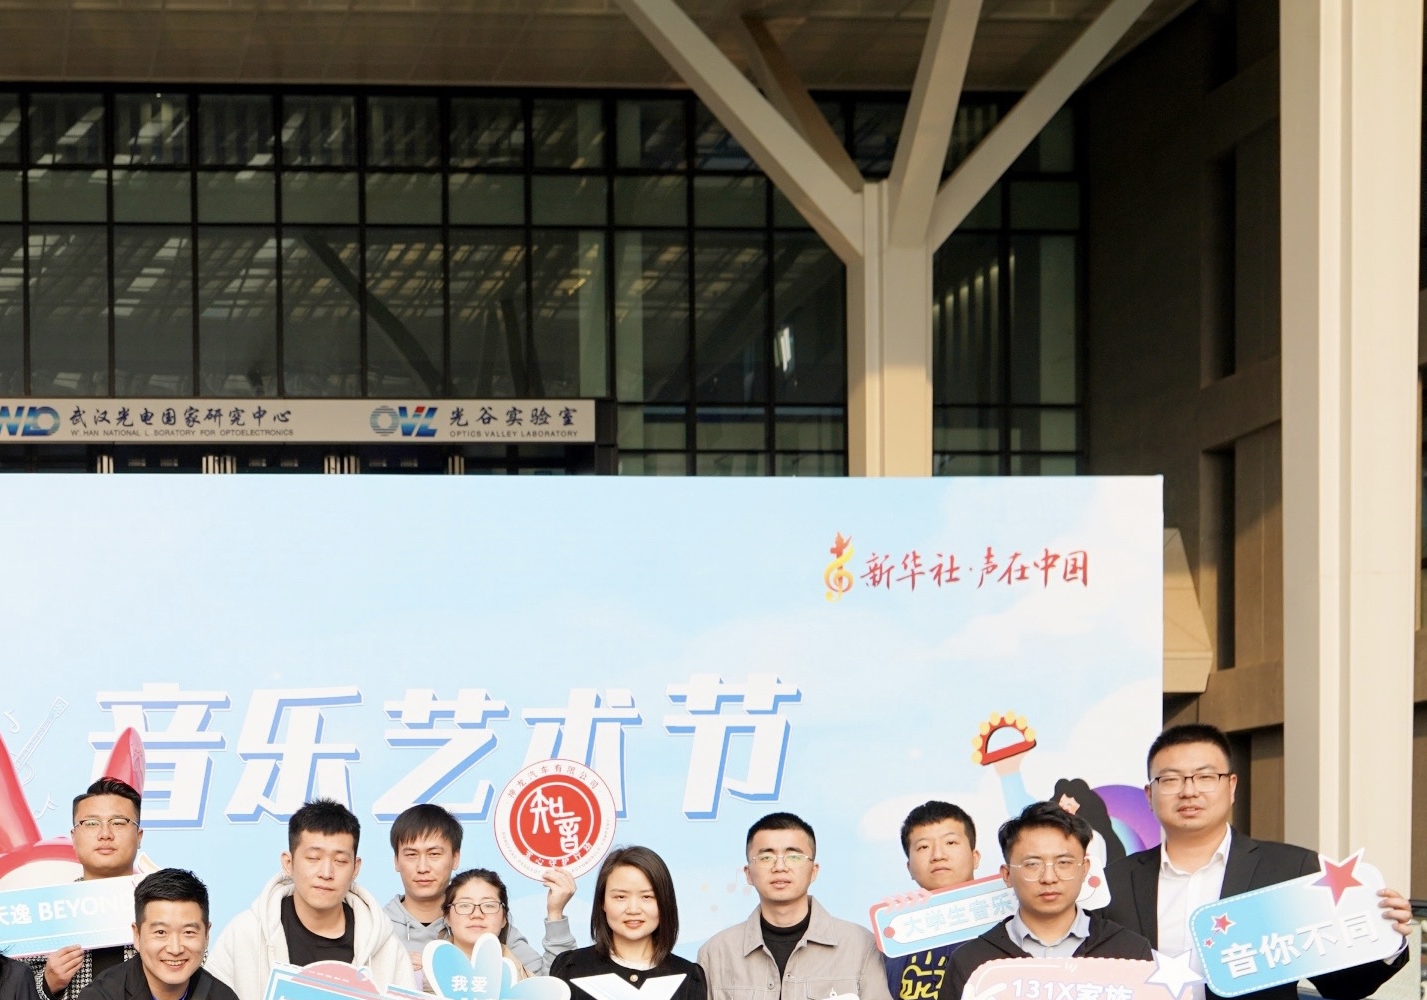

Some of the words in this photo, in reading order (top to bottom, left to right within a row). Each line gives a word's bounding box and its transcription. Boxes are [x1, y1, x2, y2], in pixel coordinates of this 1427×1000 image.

[69, 405, 292, 427] 武汉光电国家研究中心
[449, 406, 578, 427] 光谷实验室
[103, 429, 141, 437] NATIONAL
[144, 429, 195, 437] LBORATORY
[200, 429, 216, 437] FOR
[219, 429, 294, 437] OPTOELECTRONICS
[449, 430, 482, 438] OPTICS
[484, 430, 518, 438] VALLEY
[520, 430, 578, 438] LABORATORY
[507, 764, 599, 798] 神龙汽车有限公司
[903, 891, 1019, 937] 大学生音乐
[1220, 912, 1379, 979] 音你不同
